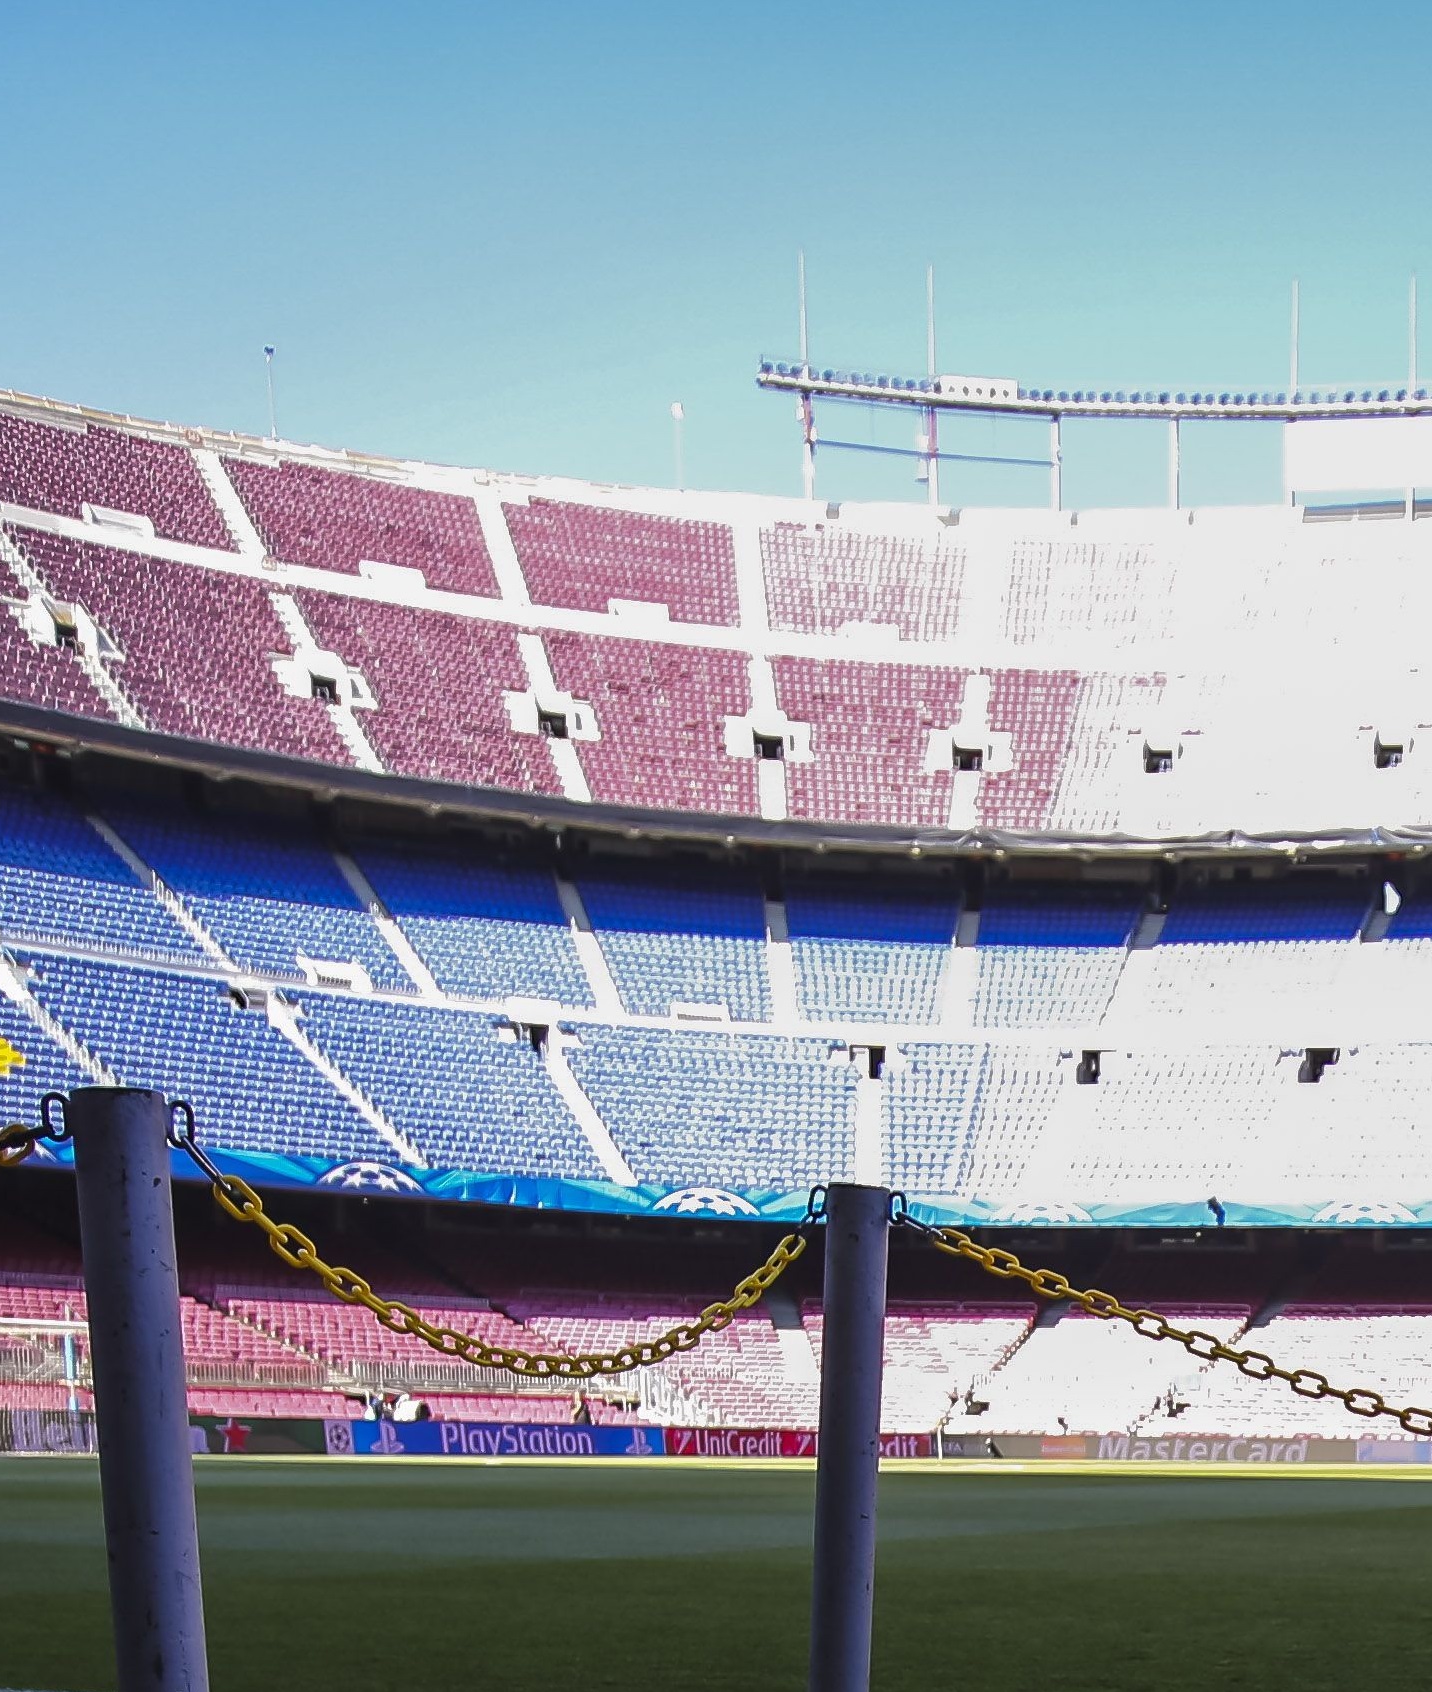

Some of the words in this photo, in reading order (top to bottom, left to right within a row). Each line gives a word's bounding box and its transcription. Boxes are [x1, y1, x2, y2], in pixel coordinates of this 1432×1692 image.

[440, 1422, 594, 1456] PlayStation
[695, 1430, 783, 1457] UniCredit
[1098, 1436, 1309, 1462] MasterCard
